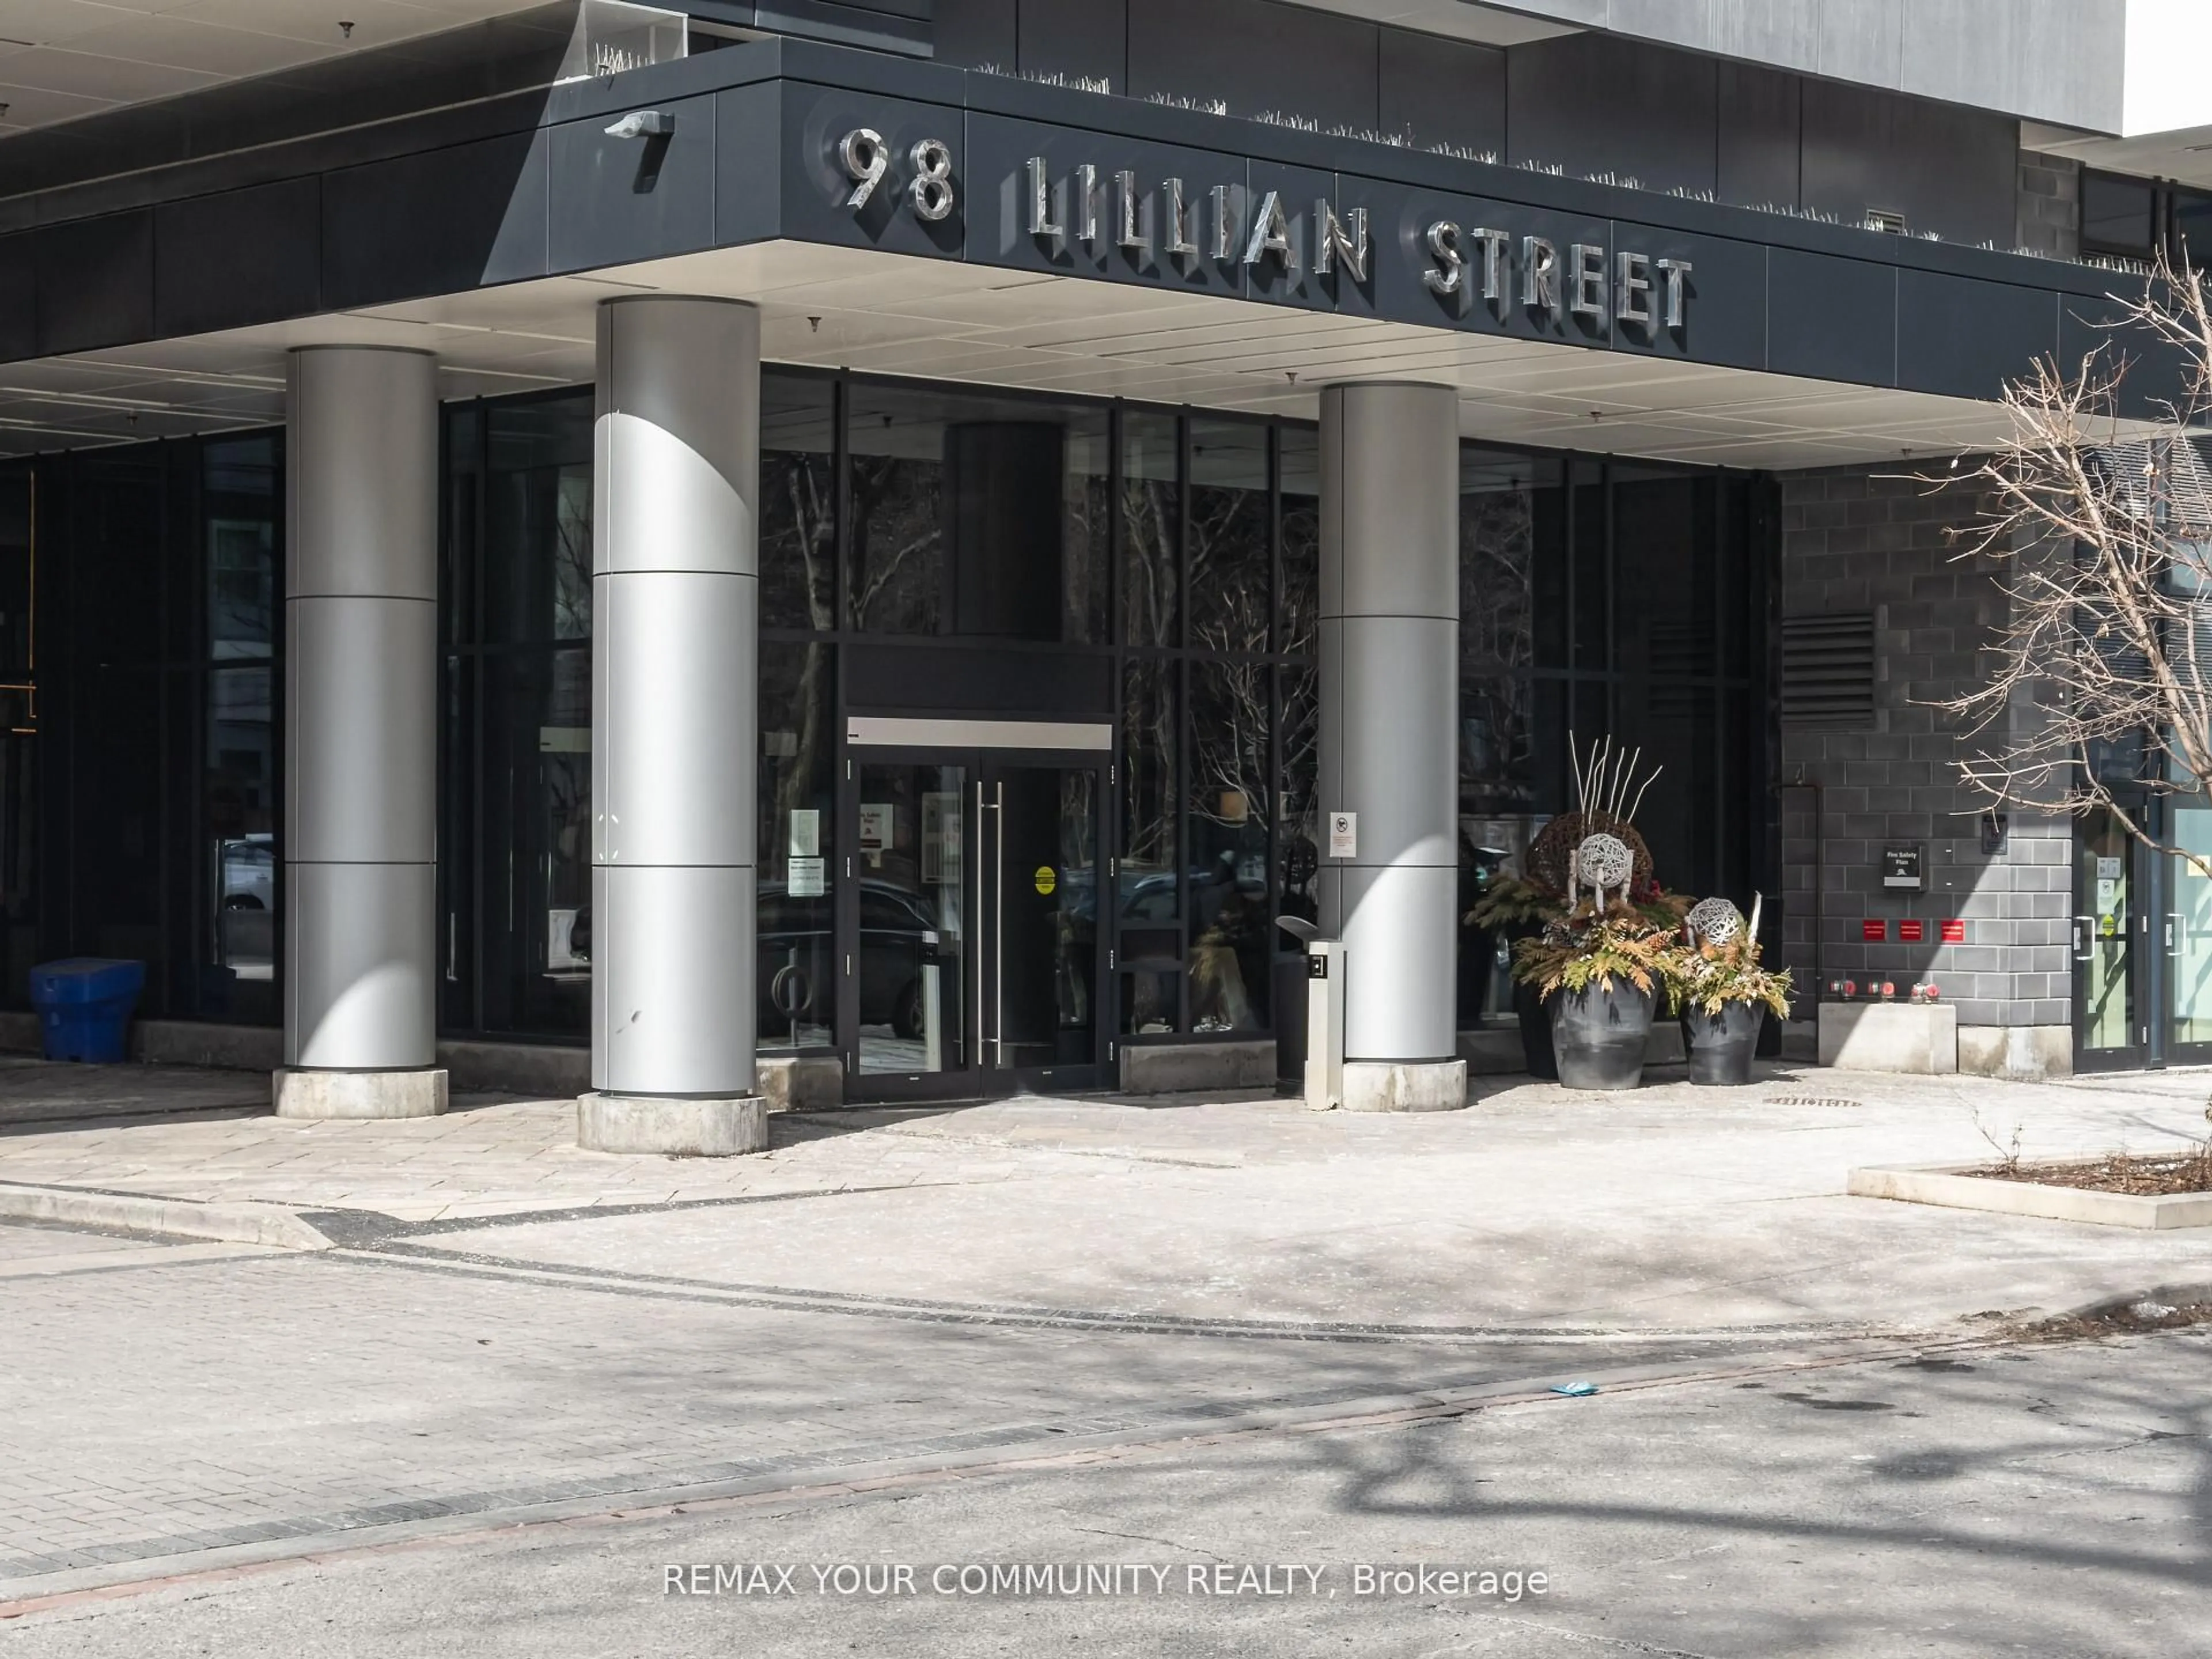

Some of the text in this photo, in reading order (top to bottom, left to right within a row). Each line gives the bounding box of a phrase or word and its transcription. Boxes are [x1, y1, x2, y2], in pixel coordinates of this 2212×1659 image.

[839, 128, 1692, 327] 98 LILLIAN STREET
